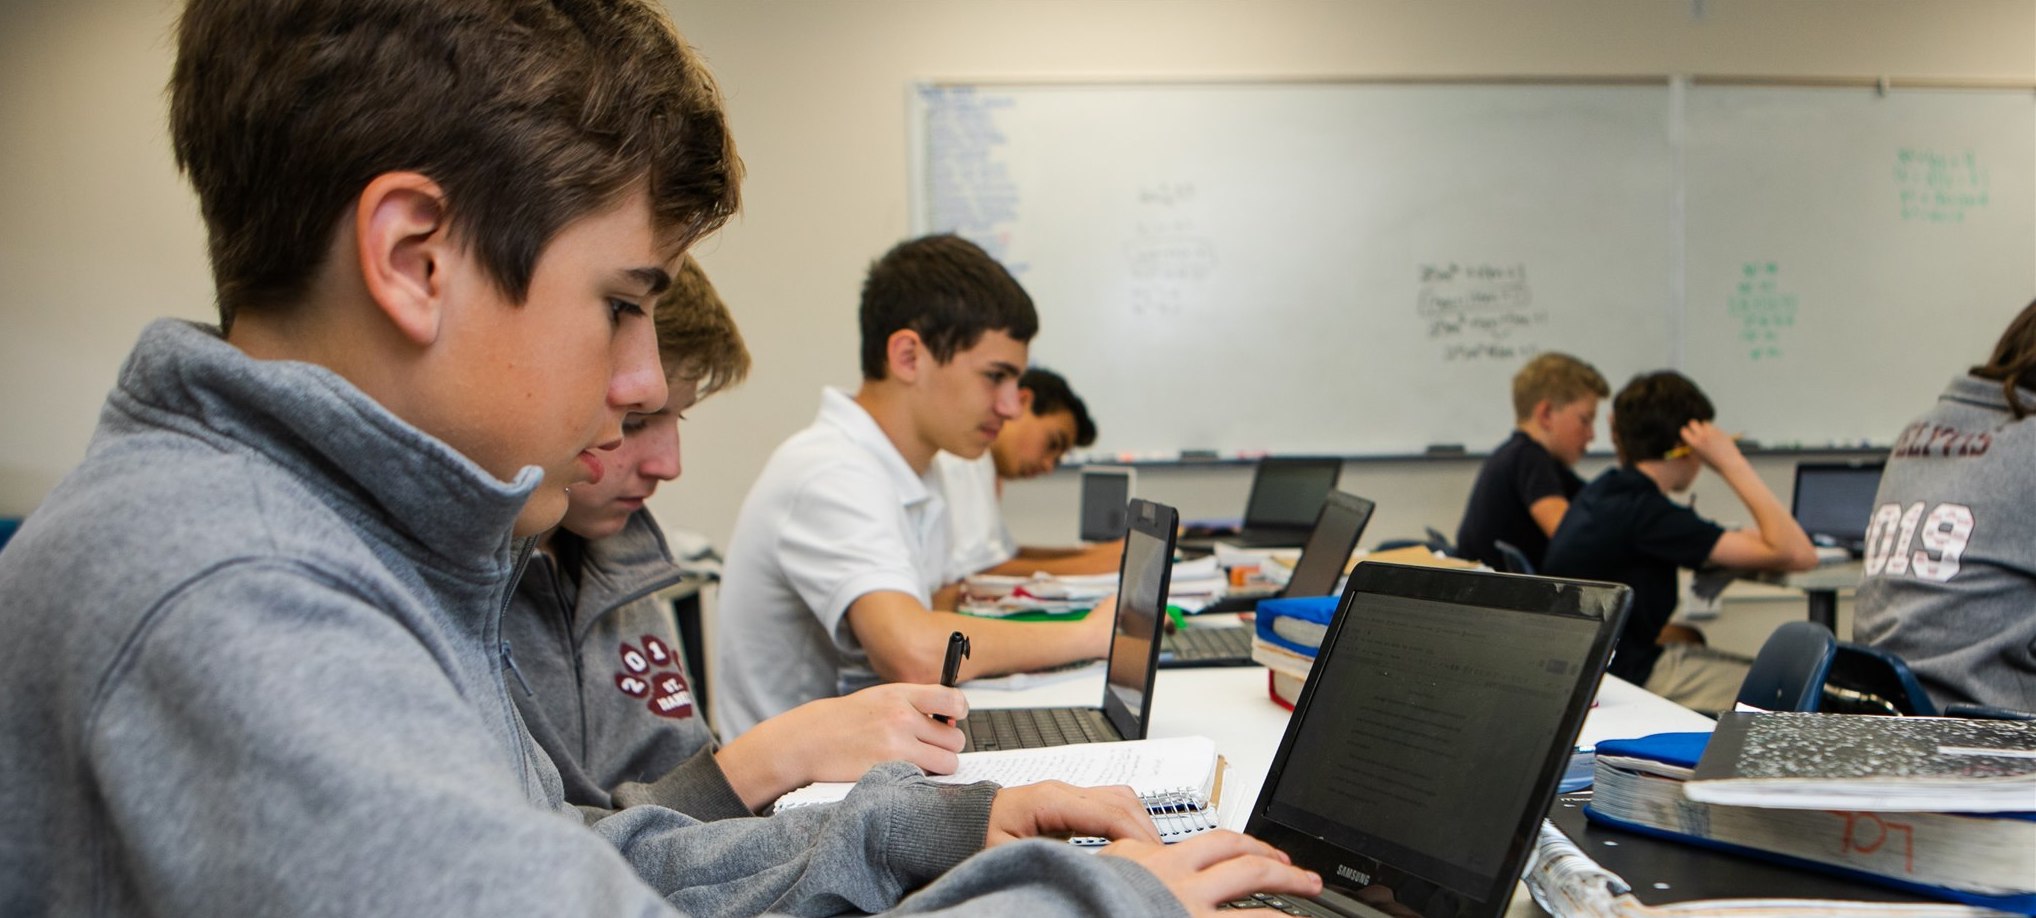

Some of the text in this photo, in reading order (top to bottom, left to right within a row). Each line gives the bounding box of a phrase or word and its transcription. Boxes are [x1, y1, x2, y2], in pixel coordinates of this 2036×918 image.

[1864, 501, 1976, 583] 019
[621, 641, 667, 694] 201
[1336, 864, 1371, 886] SAMSUNG
